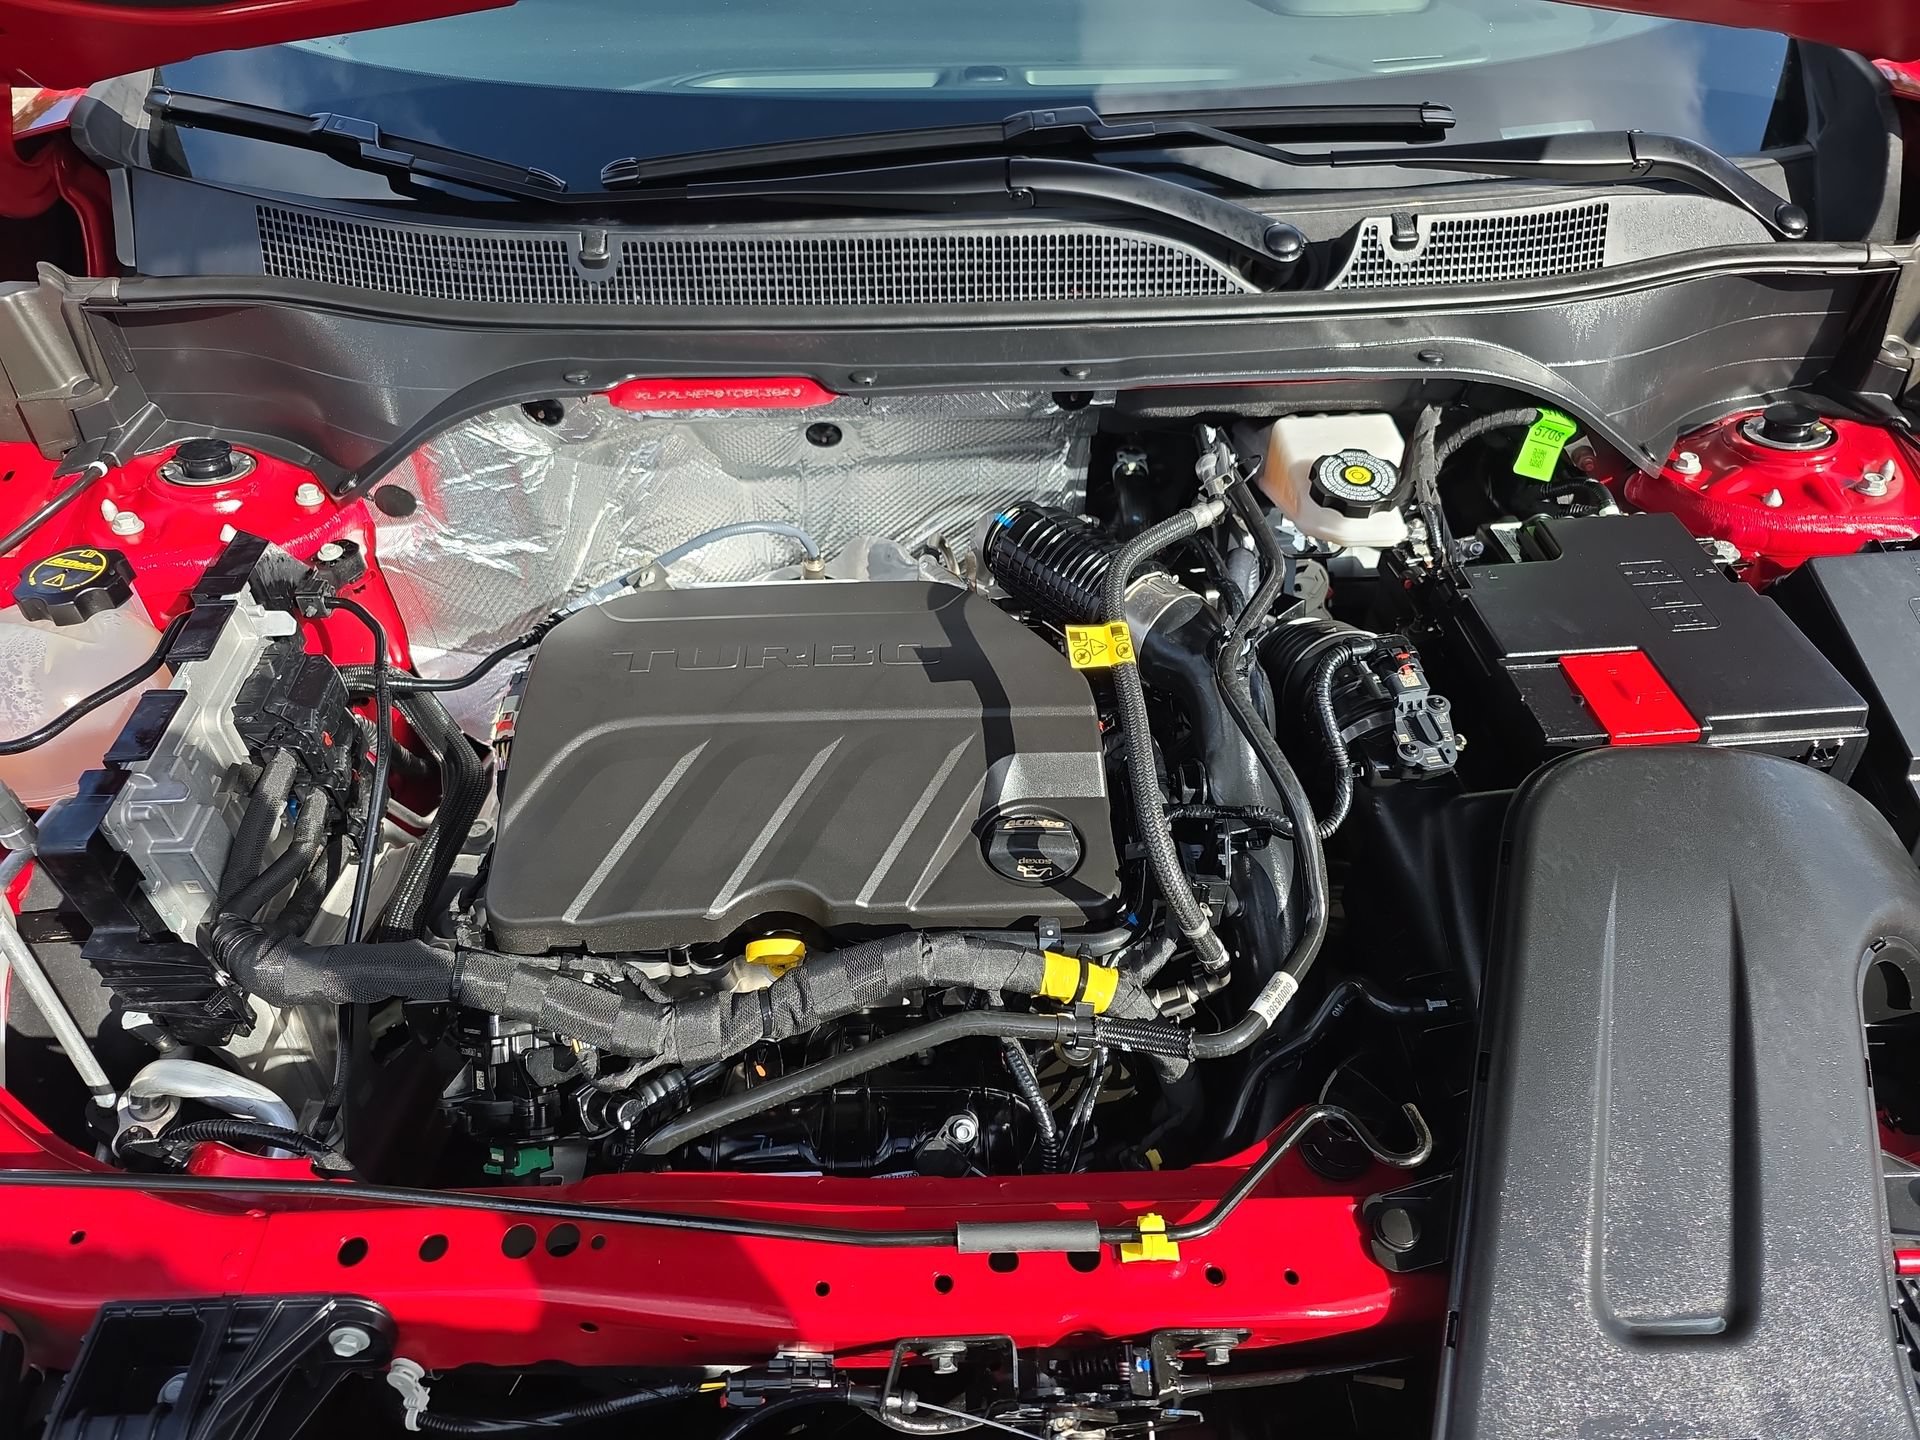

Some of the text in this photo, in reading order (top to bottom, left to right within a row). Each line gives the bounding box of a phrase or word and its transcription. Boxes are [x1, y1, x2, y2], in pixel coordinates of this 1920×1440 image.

[611, 641, 942, 674] TURBO
[1004, 819, 1065, 829] ACDelco
[1018, 857, 1053, 865] dexos
